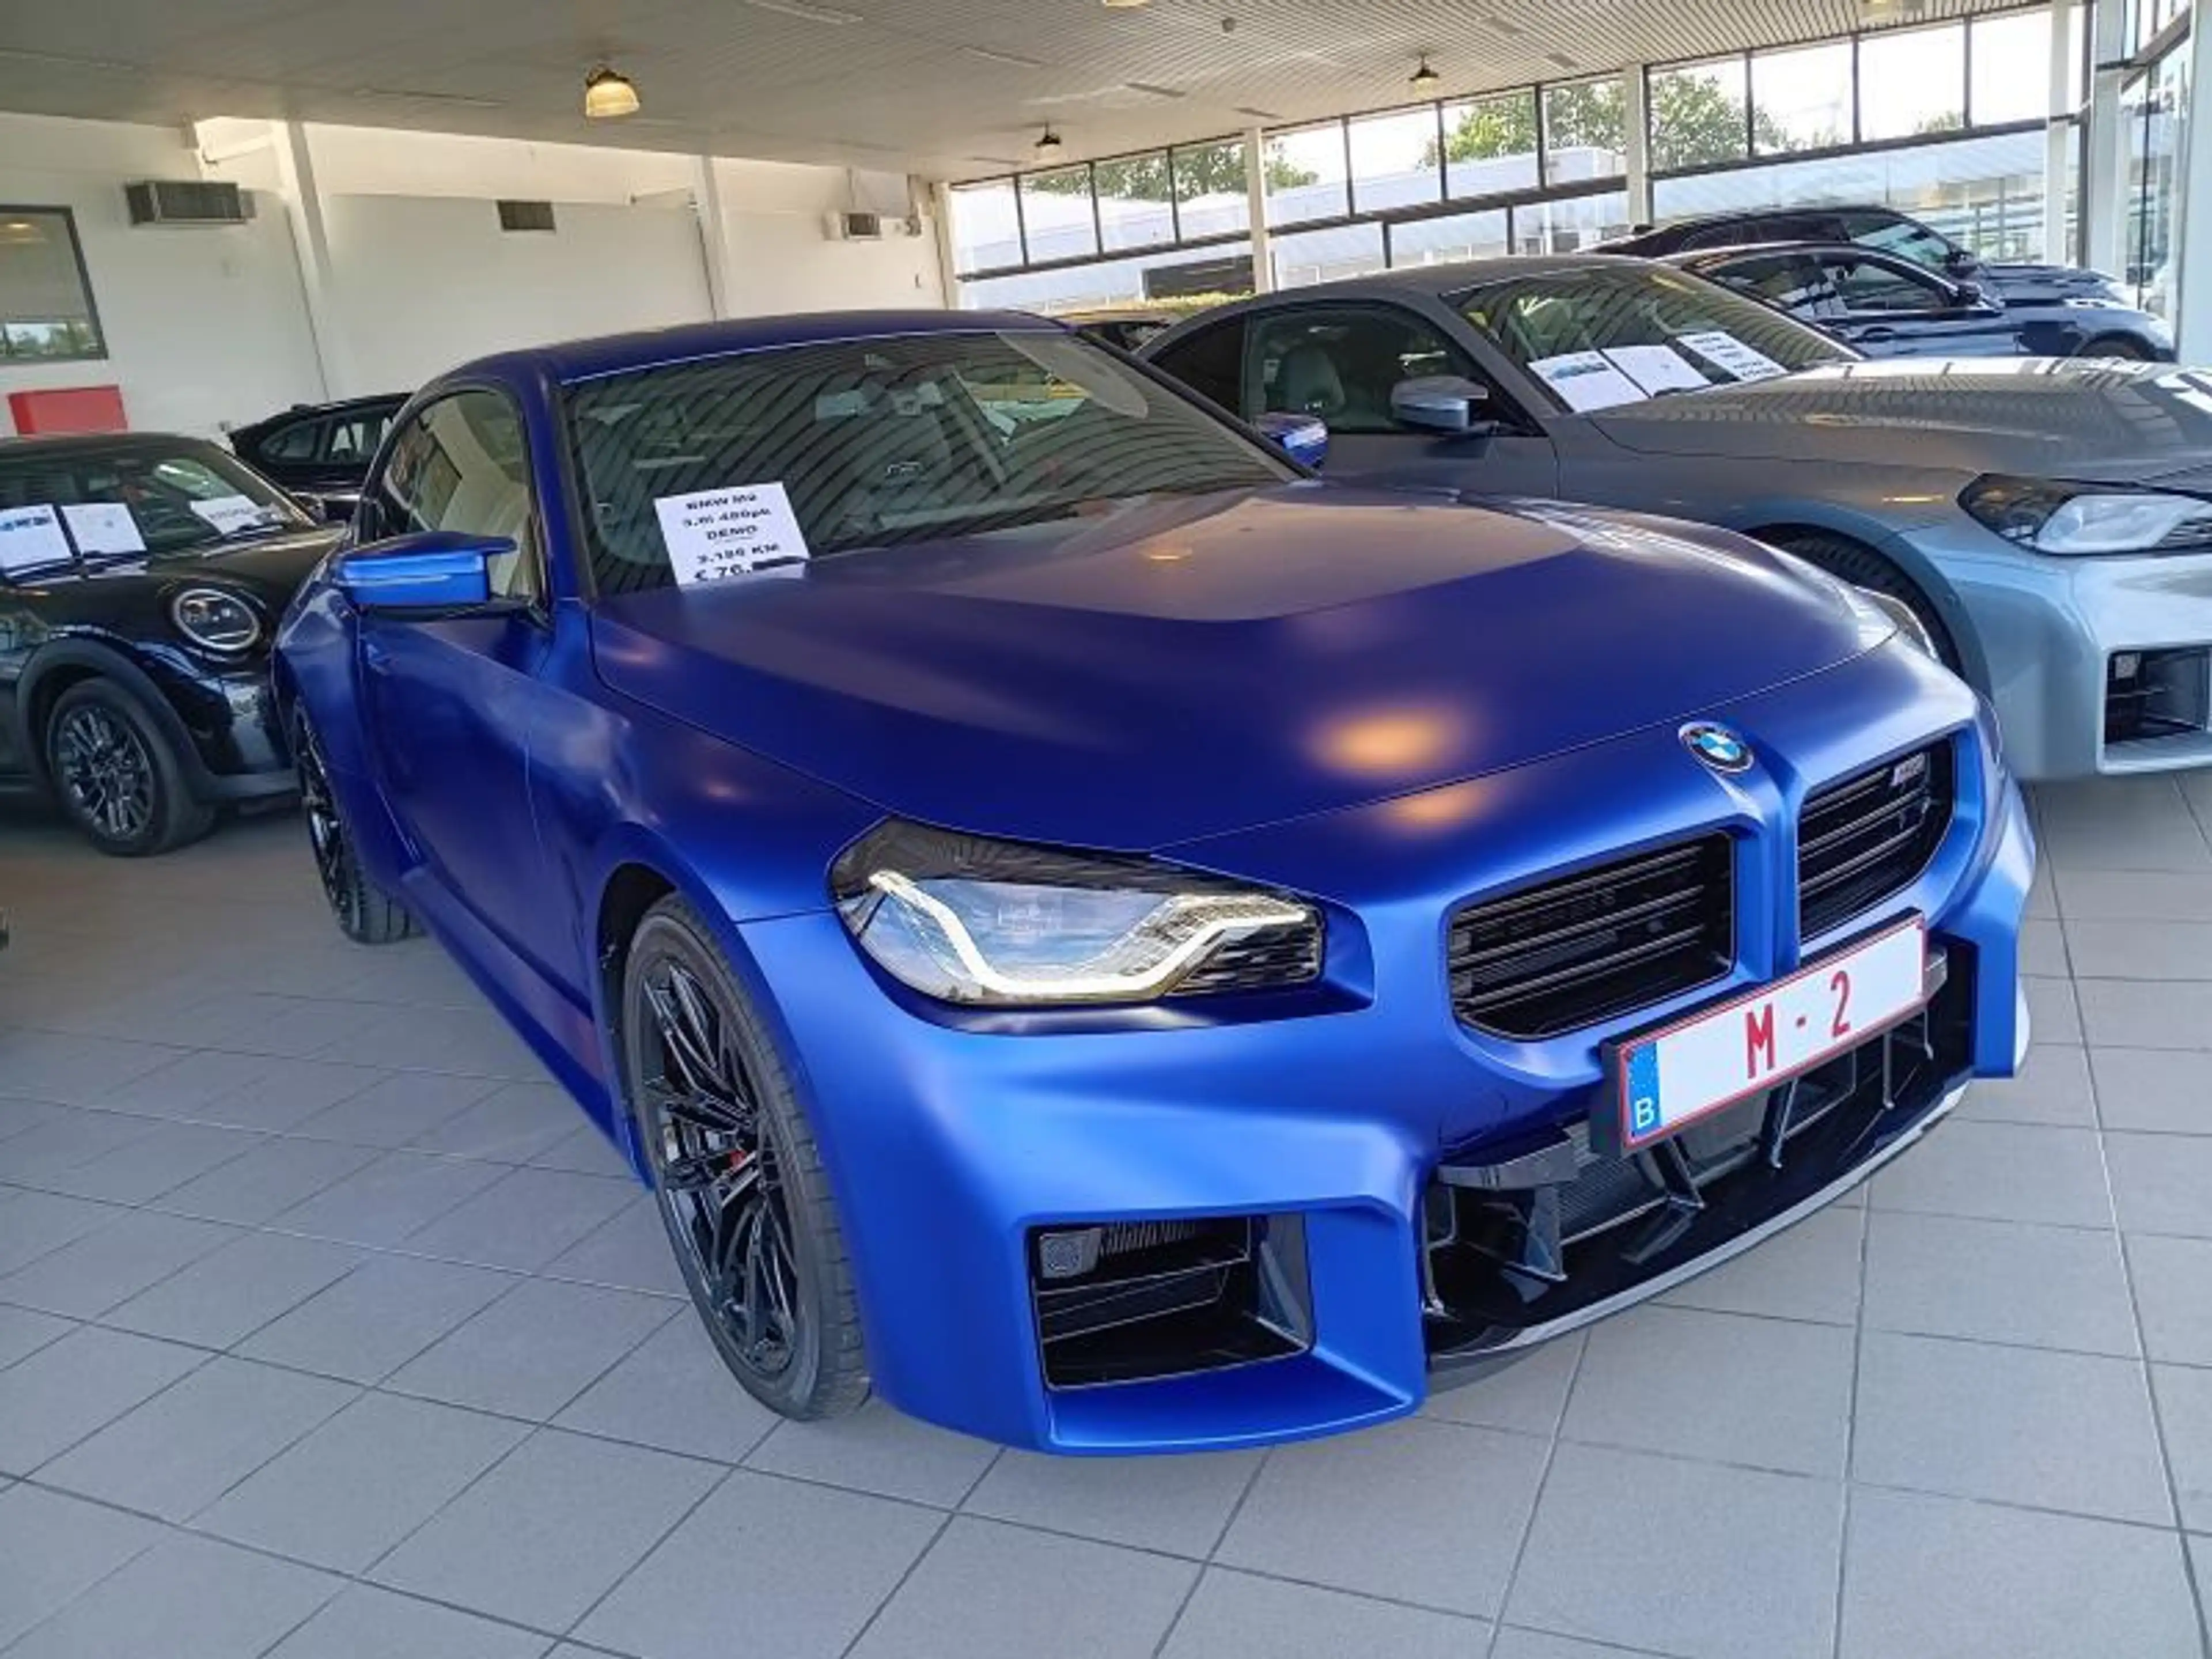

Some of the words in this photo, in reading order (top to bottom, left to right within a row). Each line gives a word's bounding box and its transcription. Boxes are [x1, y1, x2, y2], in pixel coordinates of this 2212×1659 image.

[707, 525, 757, 539] DEMO
[1745, 1003, 1776, 1079] M
[1830, 969, 1851, 1038] 2
[1634, 1097, 1654, 1129] B
